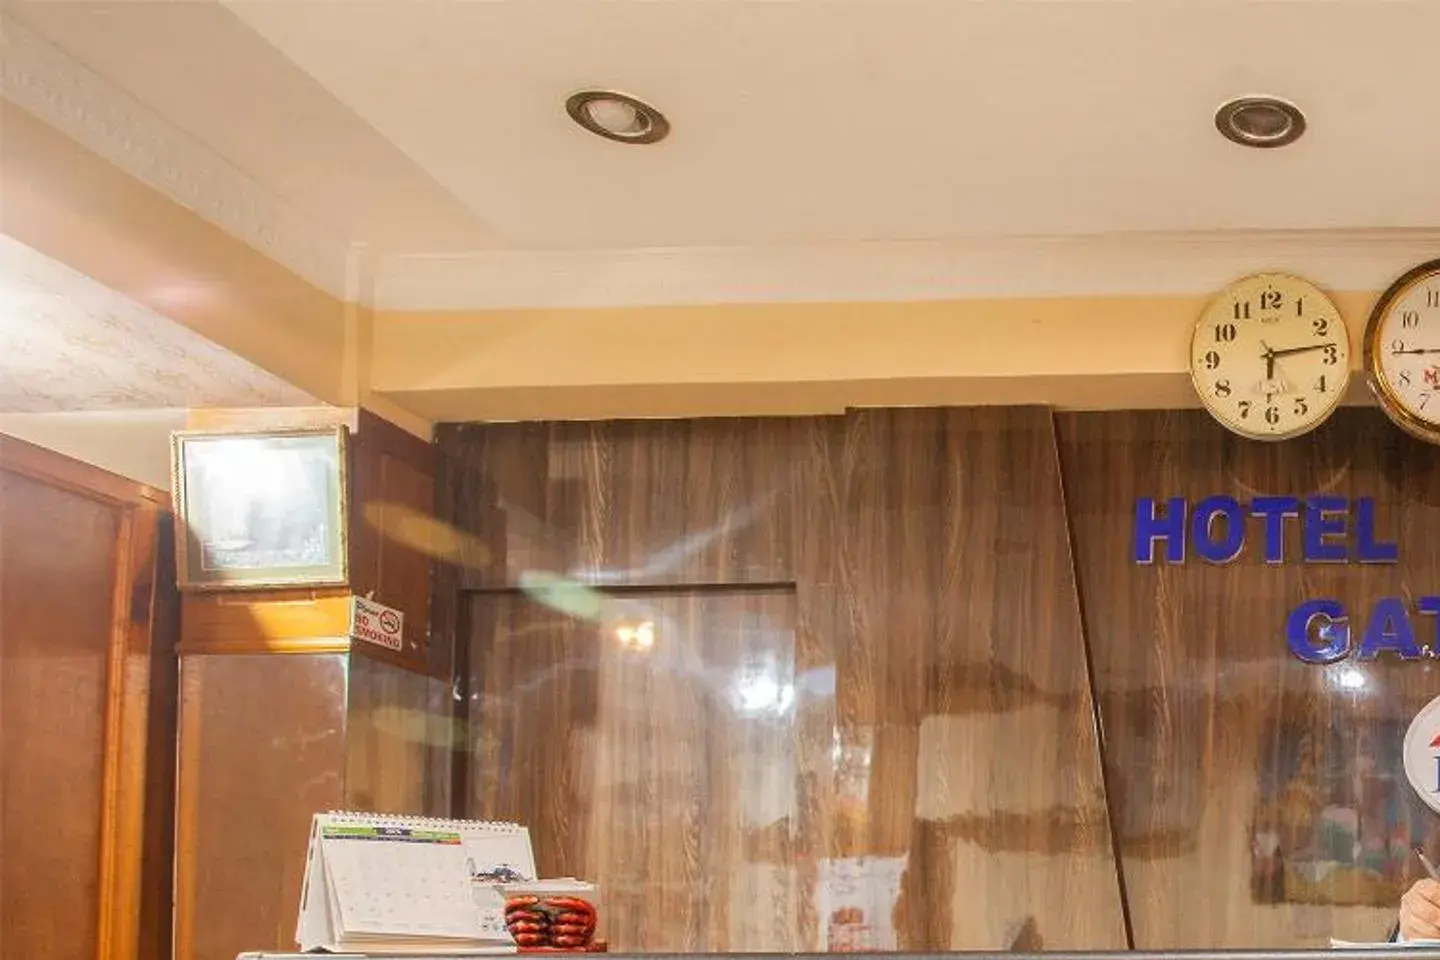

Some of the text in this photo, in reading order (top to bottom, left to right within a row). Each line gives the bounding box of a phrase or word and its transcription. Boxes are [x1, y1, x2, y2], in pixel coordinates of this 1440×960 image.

[1261, 291, 1282, 309] 12
[1427, 290, 1439, 307] 11
[1234, 302, 1250, 319] 11
[1312, 318, 1328, 336] 2
[1402, 312, 1419, 328] 10
[1215, 324, 1236, 342] 10
[1205, 351, 1219, 369] 9
[1314, 375, 1326, 392] 4
[1399, 370, 1411, 386] 8
[1215, 380, 1231, 397] 8
[1238, 401, 1252, 419] 7
[1294, 399, 1308, 415] 5
[1418, 393, 1430, 410] 7
[1265, 407, 1279, 424] 6
[1135, 494, 1399, 565] HOTEL
